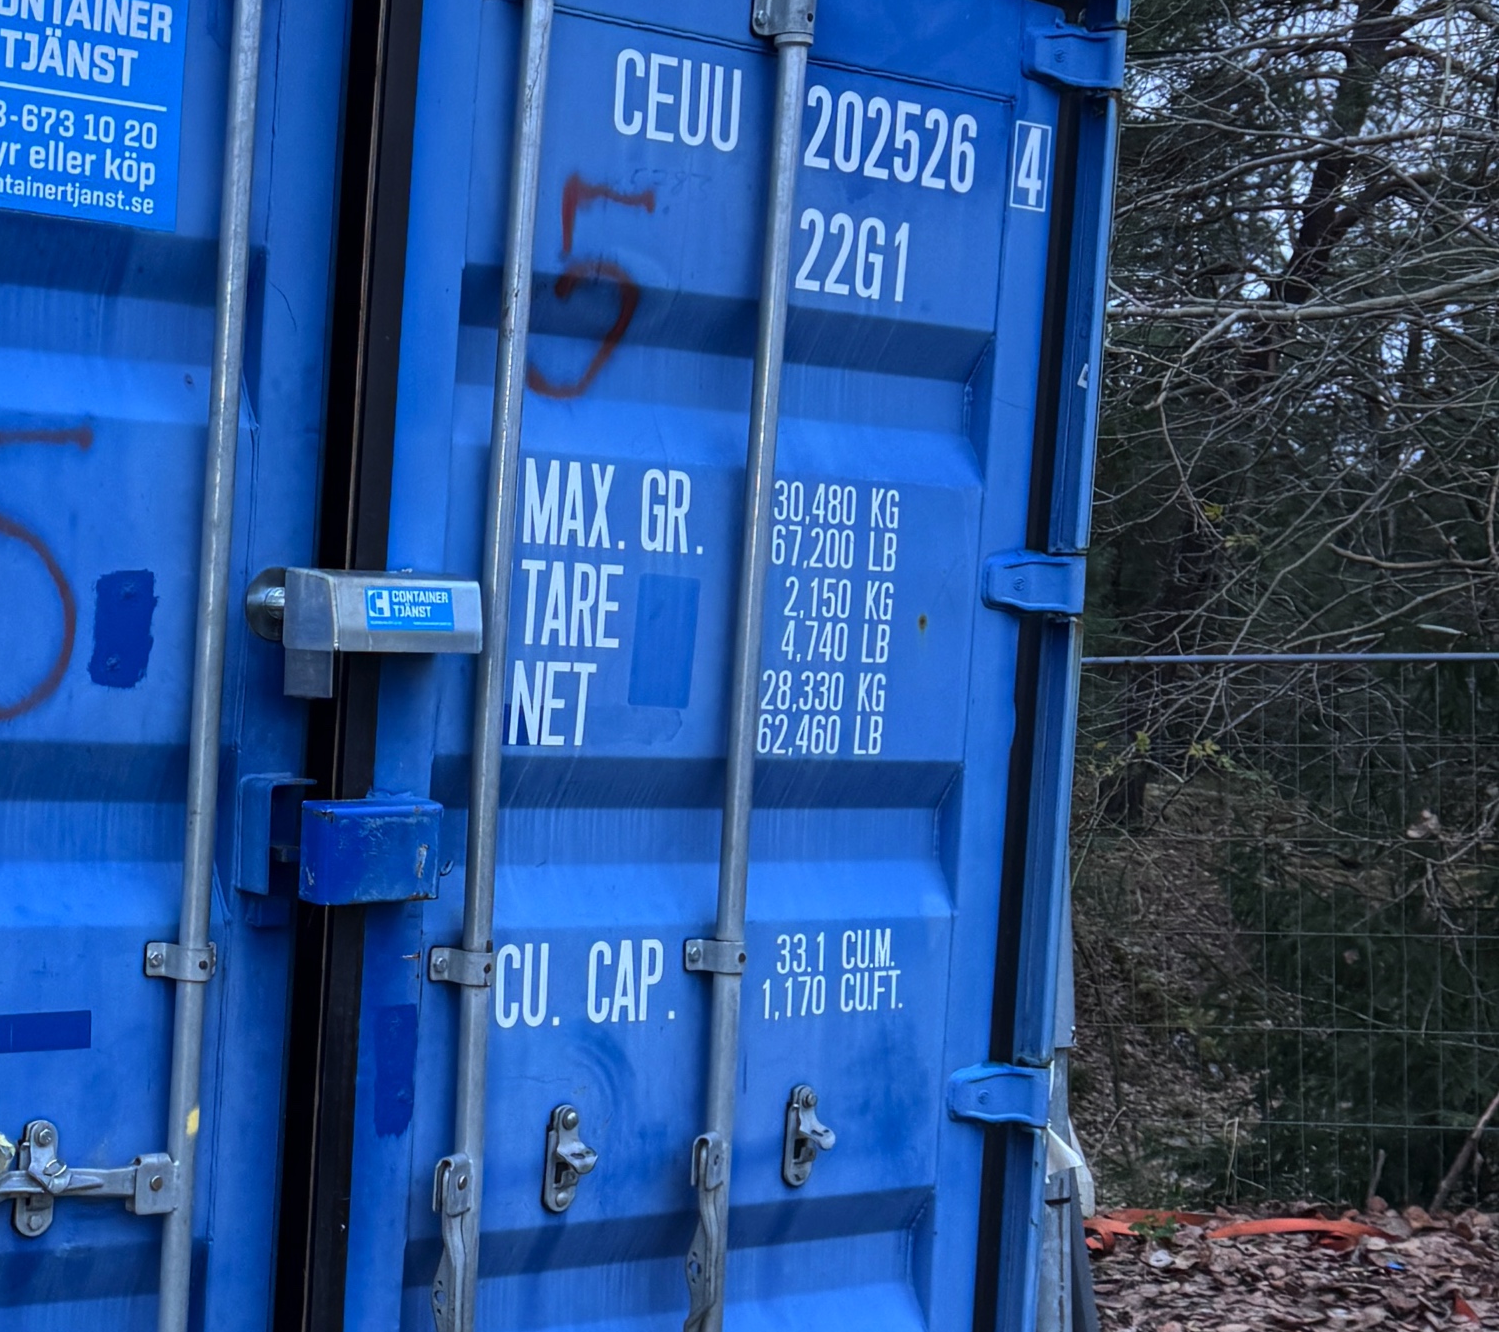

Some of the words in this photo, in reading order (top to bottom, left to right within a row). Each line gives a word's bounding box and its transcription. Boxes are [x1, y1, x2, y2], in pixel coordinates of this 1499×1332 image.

[0, 27, 138, 87] TJÄNST
[84, 109, 116, 143] 10
[123, 116, 158, 150] 20
[614, 48, 742, 152] CEUU
[803, 84, 978, 193] 202526
[1017, 125, 1043, 206] 4
[28, 137, 95, 177] eller
[104, 143, 156, 192] köp
[795, 207, 910, 302] 22G1
[522, 457, 626, 550] MAX.
[641, 468, 703, 555] GR.
[774, 480, 856, 527] 30,480
[870, 487, 899, 529] KG
[771, 525, 855, 570] 67,200
[868, 532, 897, 572] LB
[391, 590, 449, 603] CONTAINER
[393, 603, 431, 618] TJÄNST
[521, 559, 624, 648] TARE
[785, 577, 852, 620] 2,150
[864, 581, 894, 621] KG
[781, 620, 848, 662] 4,740
[861, 624, 889, 664] LB
[508, 661, 597, 746] NET
[761, 669, 844, 713] 28,330
[857, 672, 885, 712] KG
[756, 715, 840, 756] 62,460
[853, 716, 882, 755] LB
[776, 932, 826, 974] 33.1
[842, 928, 895, 970] CU.M.
[495, 943, 560, 1028] CU.
[587, 938, 675, 1023] CAP.
[762, 976, 826, 1021] 1,170
[840, 970, 903, 1013] CU.FT.
